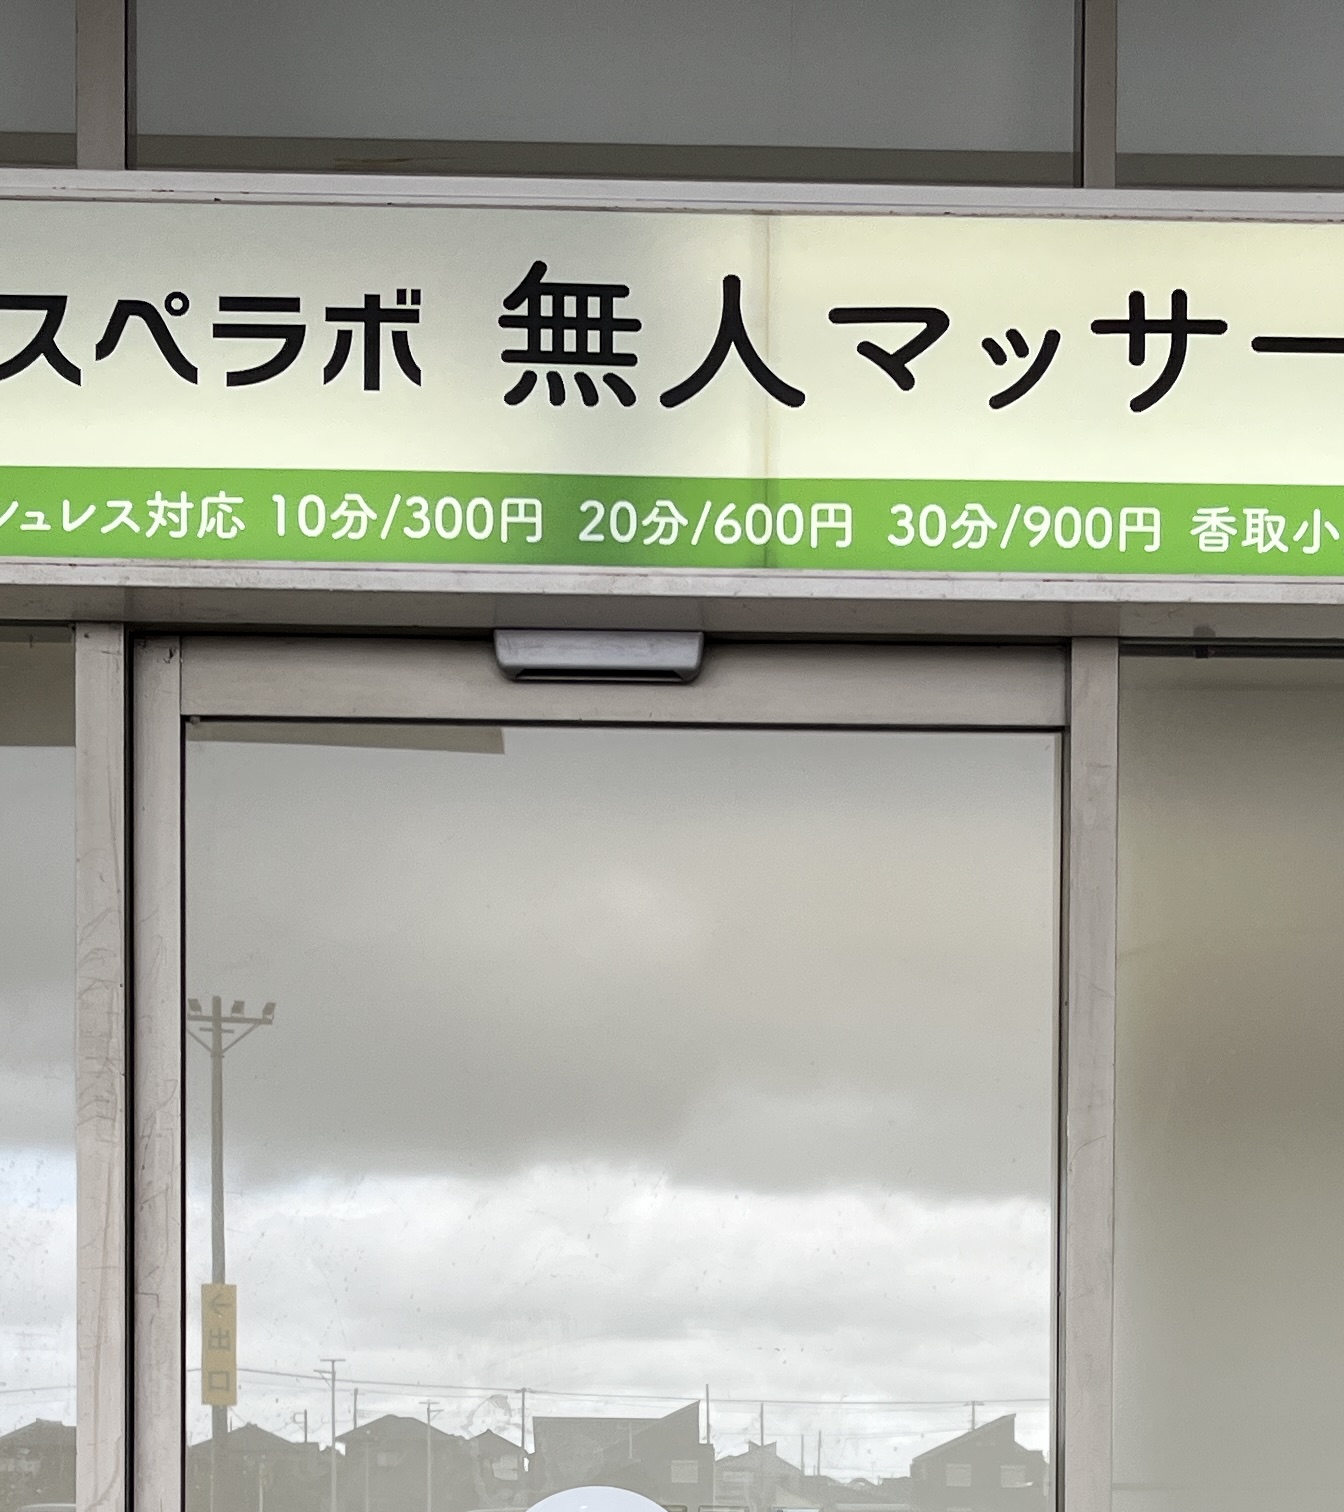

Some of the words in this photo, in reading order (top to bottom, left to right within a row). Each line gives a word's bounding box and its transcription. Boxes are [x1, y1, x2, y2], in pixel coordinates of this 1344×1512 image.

[272, 493, 542, 543] 10分/300円
[579, 500, 852, 548] 20分/600円
[888, 503, 1160, 552] 30分/900円
